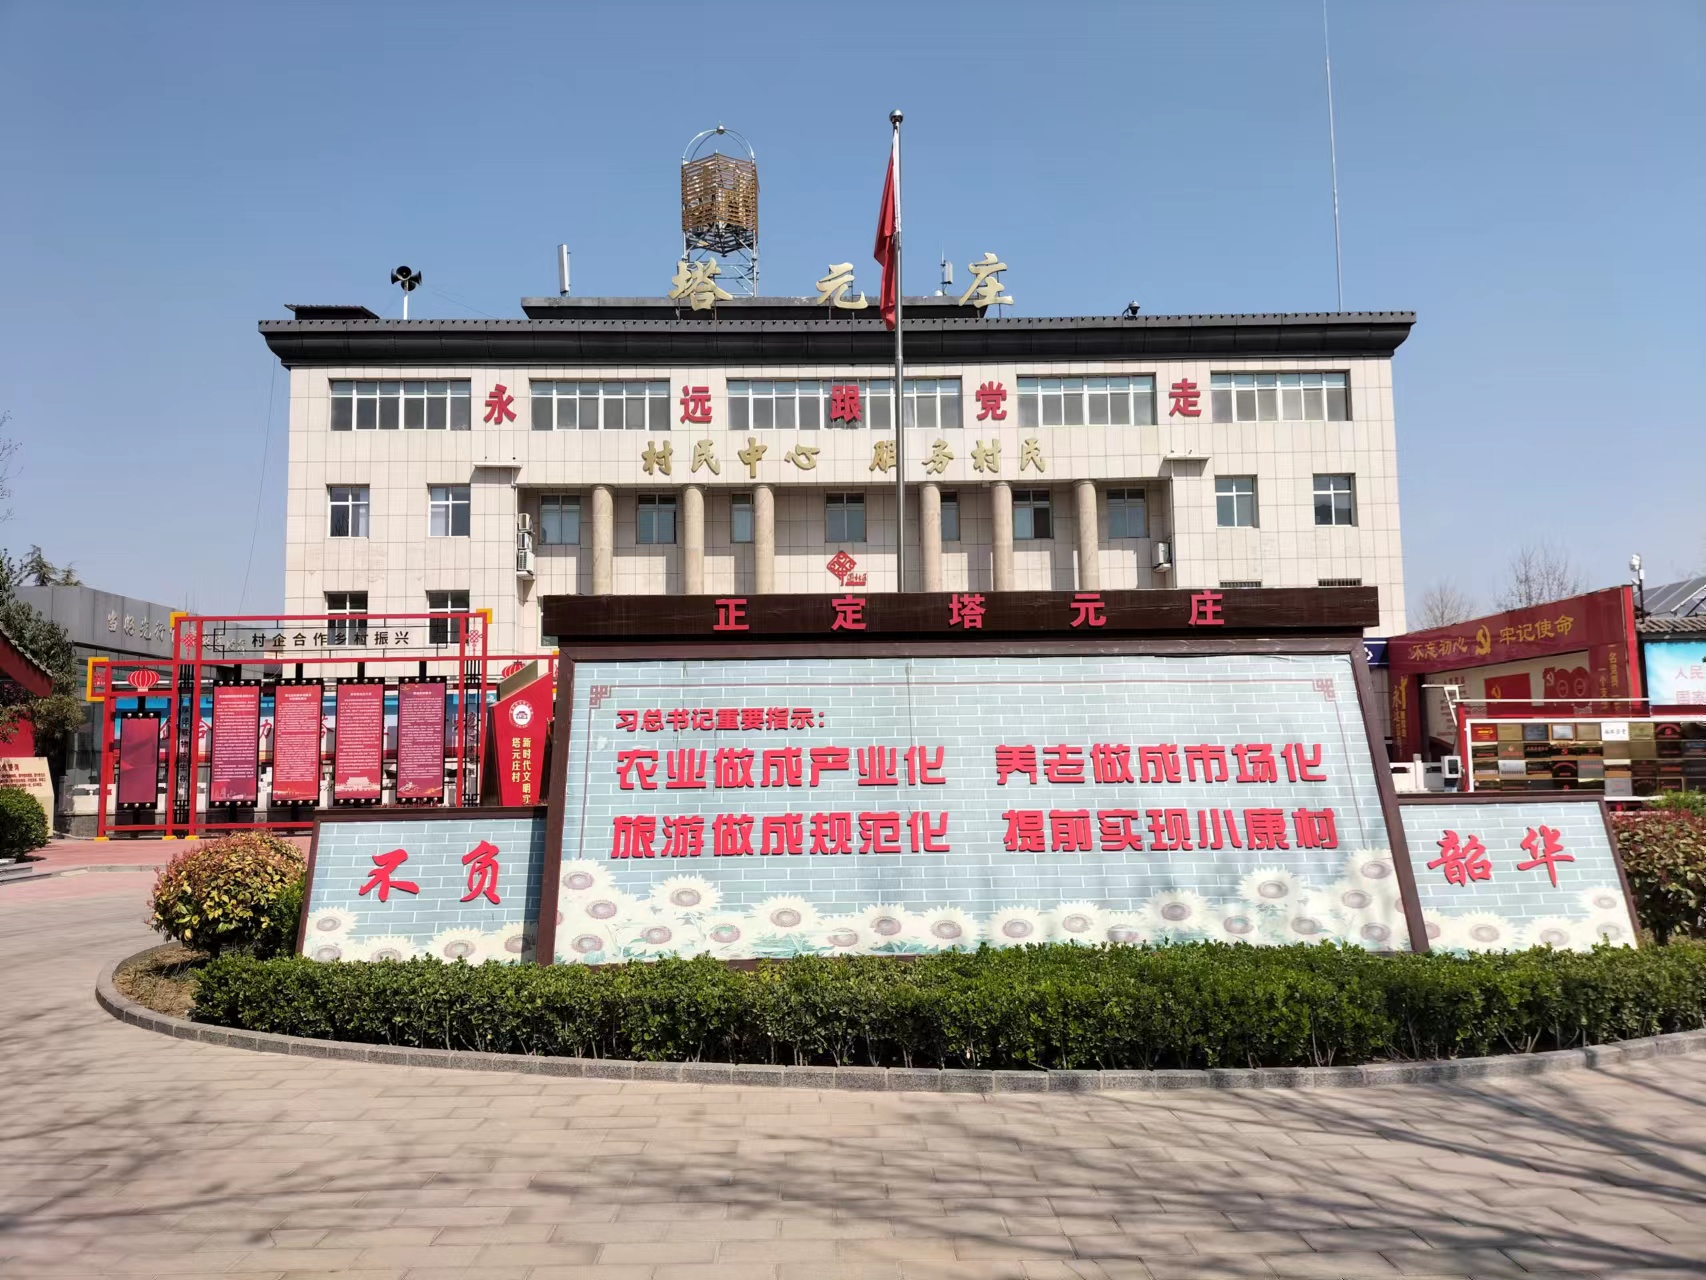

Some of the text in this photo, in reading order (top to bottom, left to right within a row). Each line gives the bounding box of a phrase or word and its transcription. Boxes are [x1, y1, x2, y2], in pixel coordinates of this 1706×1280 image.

[669, 251, 1014, 310] 塔元庄
[484, 378, 1202, 425] 永远跟党走
[641, 437, 1047, 478] 村民中心 服务村民
[713, 593, 1225, 631] 正定塔元庄
[1499, 614, 1575, 645] 牢记使命
[252, 631, 409, 648] 村企合作乡村振兴
[511, 737, 521, 783] 塔元庄村
[616, 743, 1328, 789] 农业做成产业化 养老做成市场化
[611, 808, 1339, 858] 旅游做成规范化 提前实现小康村
[1428, 825, 1575, 887] 韶华
[358, 840, 501, 904] 不负
